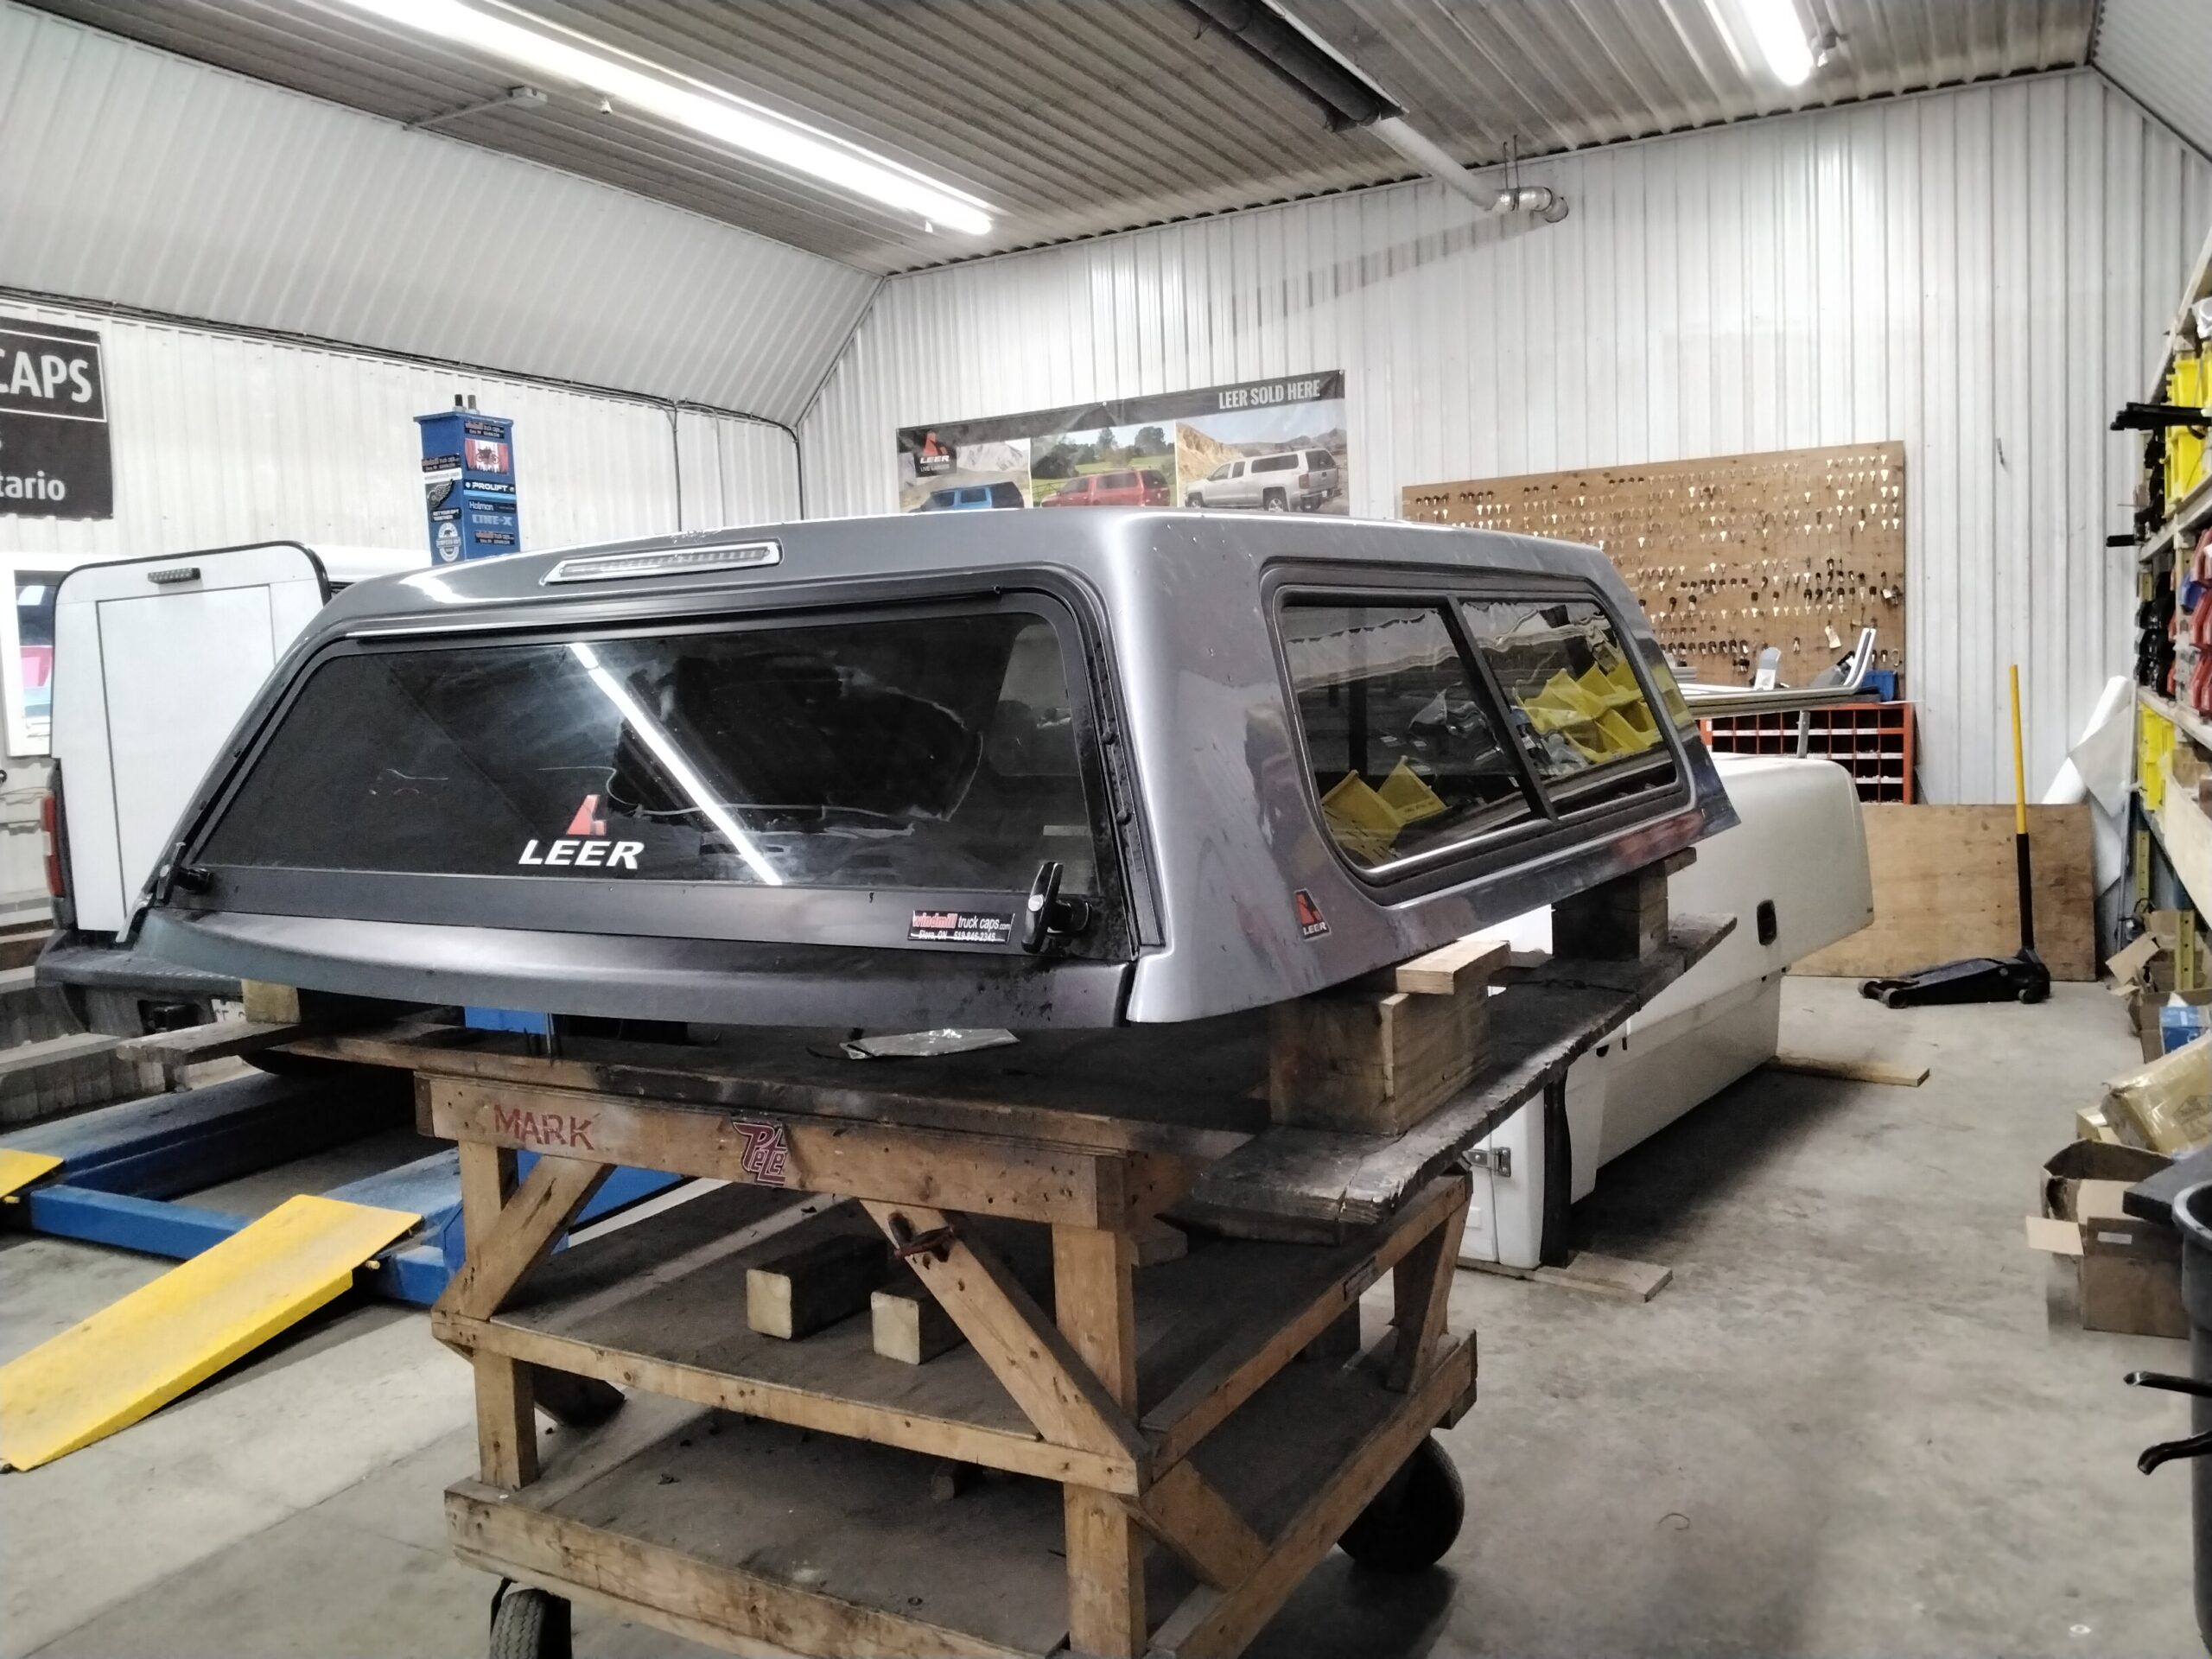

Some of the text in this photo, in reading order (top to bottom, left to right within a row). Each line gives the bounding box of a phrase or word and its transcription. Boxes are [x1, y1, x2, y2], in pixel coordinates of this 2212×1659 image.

[1218, 379, 1320, 410] LEER SOLD HERE
[920, 454, 950, 463] LEER
[472, 481, 508, 492] PROLIFT
[518, 839, 645, 869] LEER
[912, 912, 957, 929] windmill
[958, 916, 978, 929] truck
[1303, 921, 1327, 936] LEER
[493, 1103, 596, 1151] MARK
